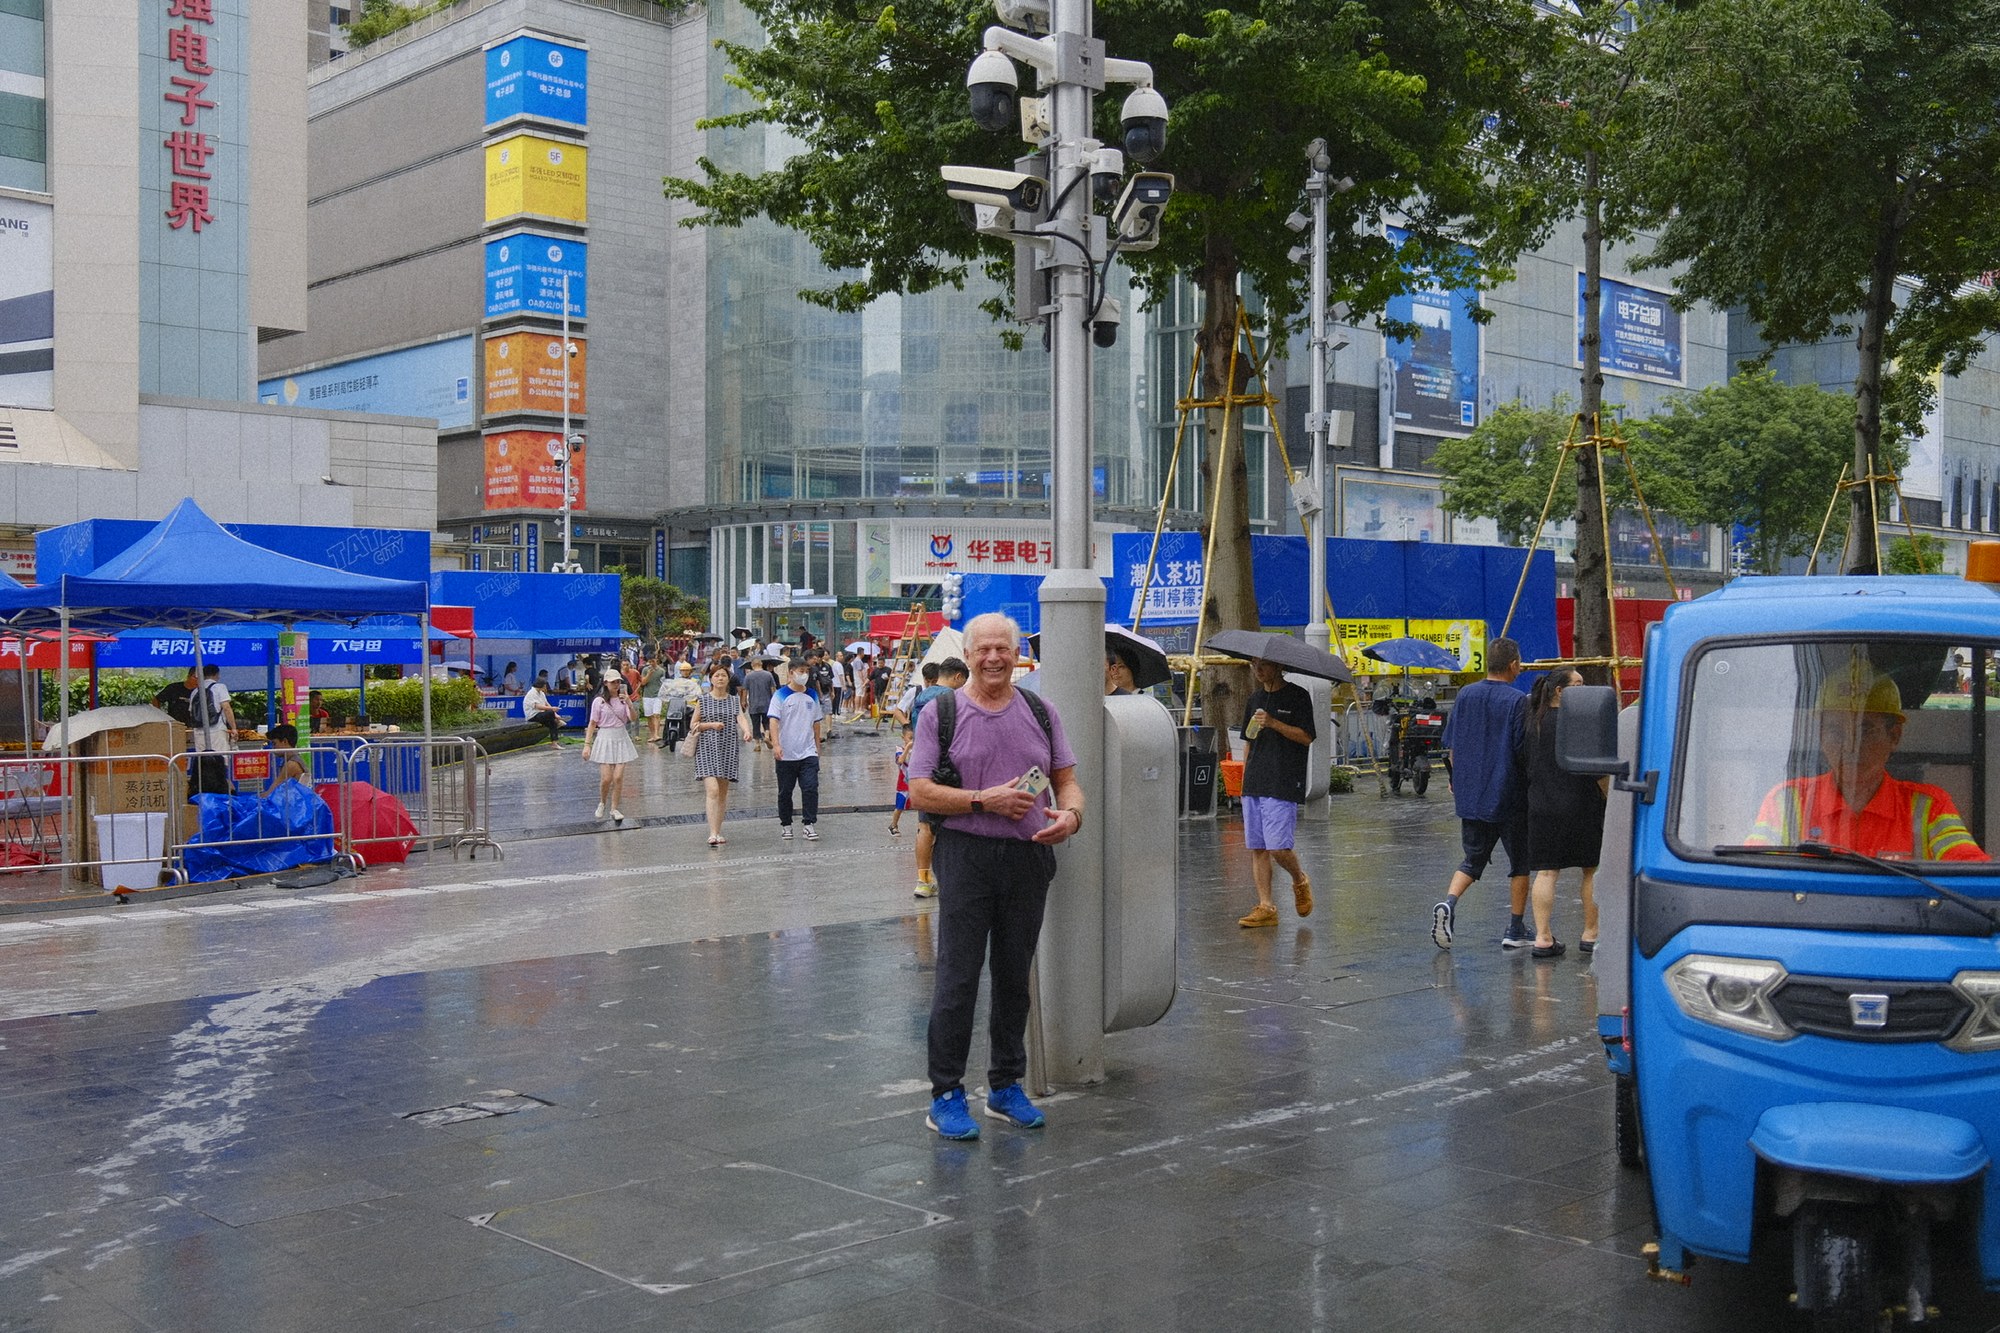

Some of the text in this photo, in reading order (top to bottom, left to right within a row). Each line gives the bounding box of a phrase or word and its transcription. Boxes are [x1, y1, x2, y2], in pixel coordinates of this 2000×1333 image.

[540, 83, 572, 98] 电子总部
[550, 151, 561, 161] 5F
[0, 218, 29, 230] ANG
[549, 249, 560, 258] 4F
[1618, 300, 1661, 327] 电子总部
[549, 346, 560, 355] 3F
[1130, 560, 1202, 587] 潮人茶坊
[151, 640, 227, 656] 烤肉大串
[1473, 651, 1482, 671] 3
[125, 780, 166, 793] 蒸发式
[125, 795, 167, 809] 冷风机
